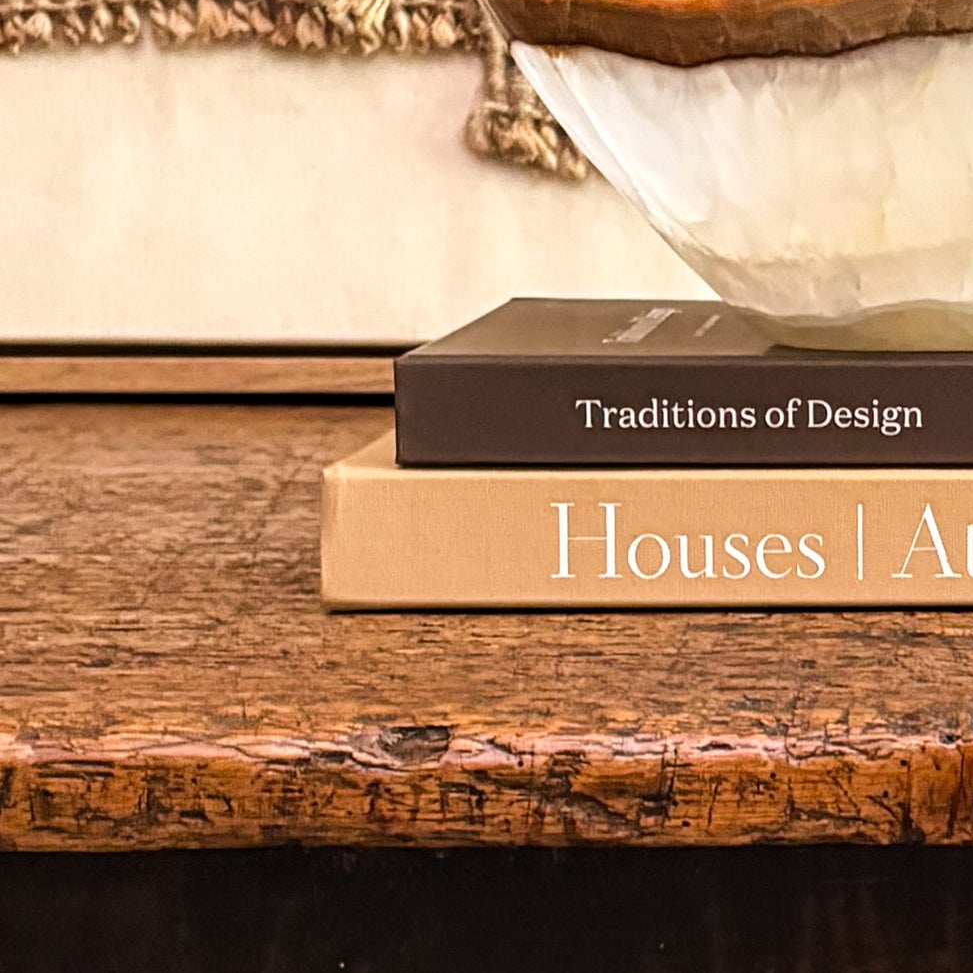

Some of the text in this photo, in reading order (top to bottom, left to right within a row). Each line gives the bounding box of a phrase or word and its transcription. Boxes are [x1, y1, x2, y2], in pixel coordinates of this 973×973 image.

[575, 397, 923, 437] Traditions of Design
[550, 502, 826, 580] Houses
